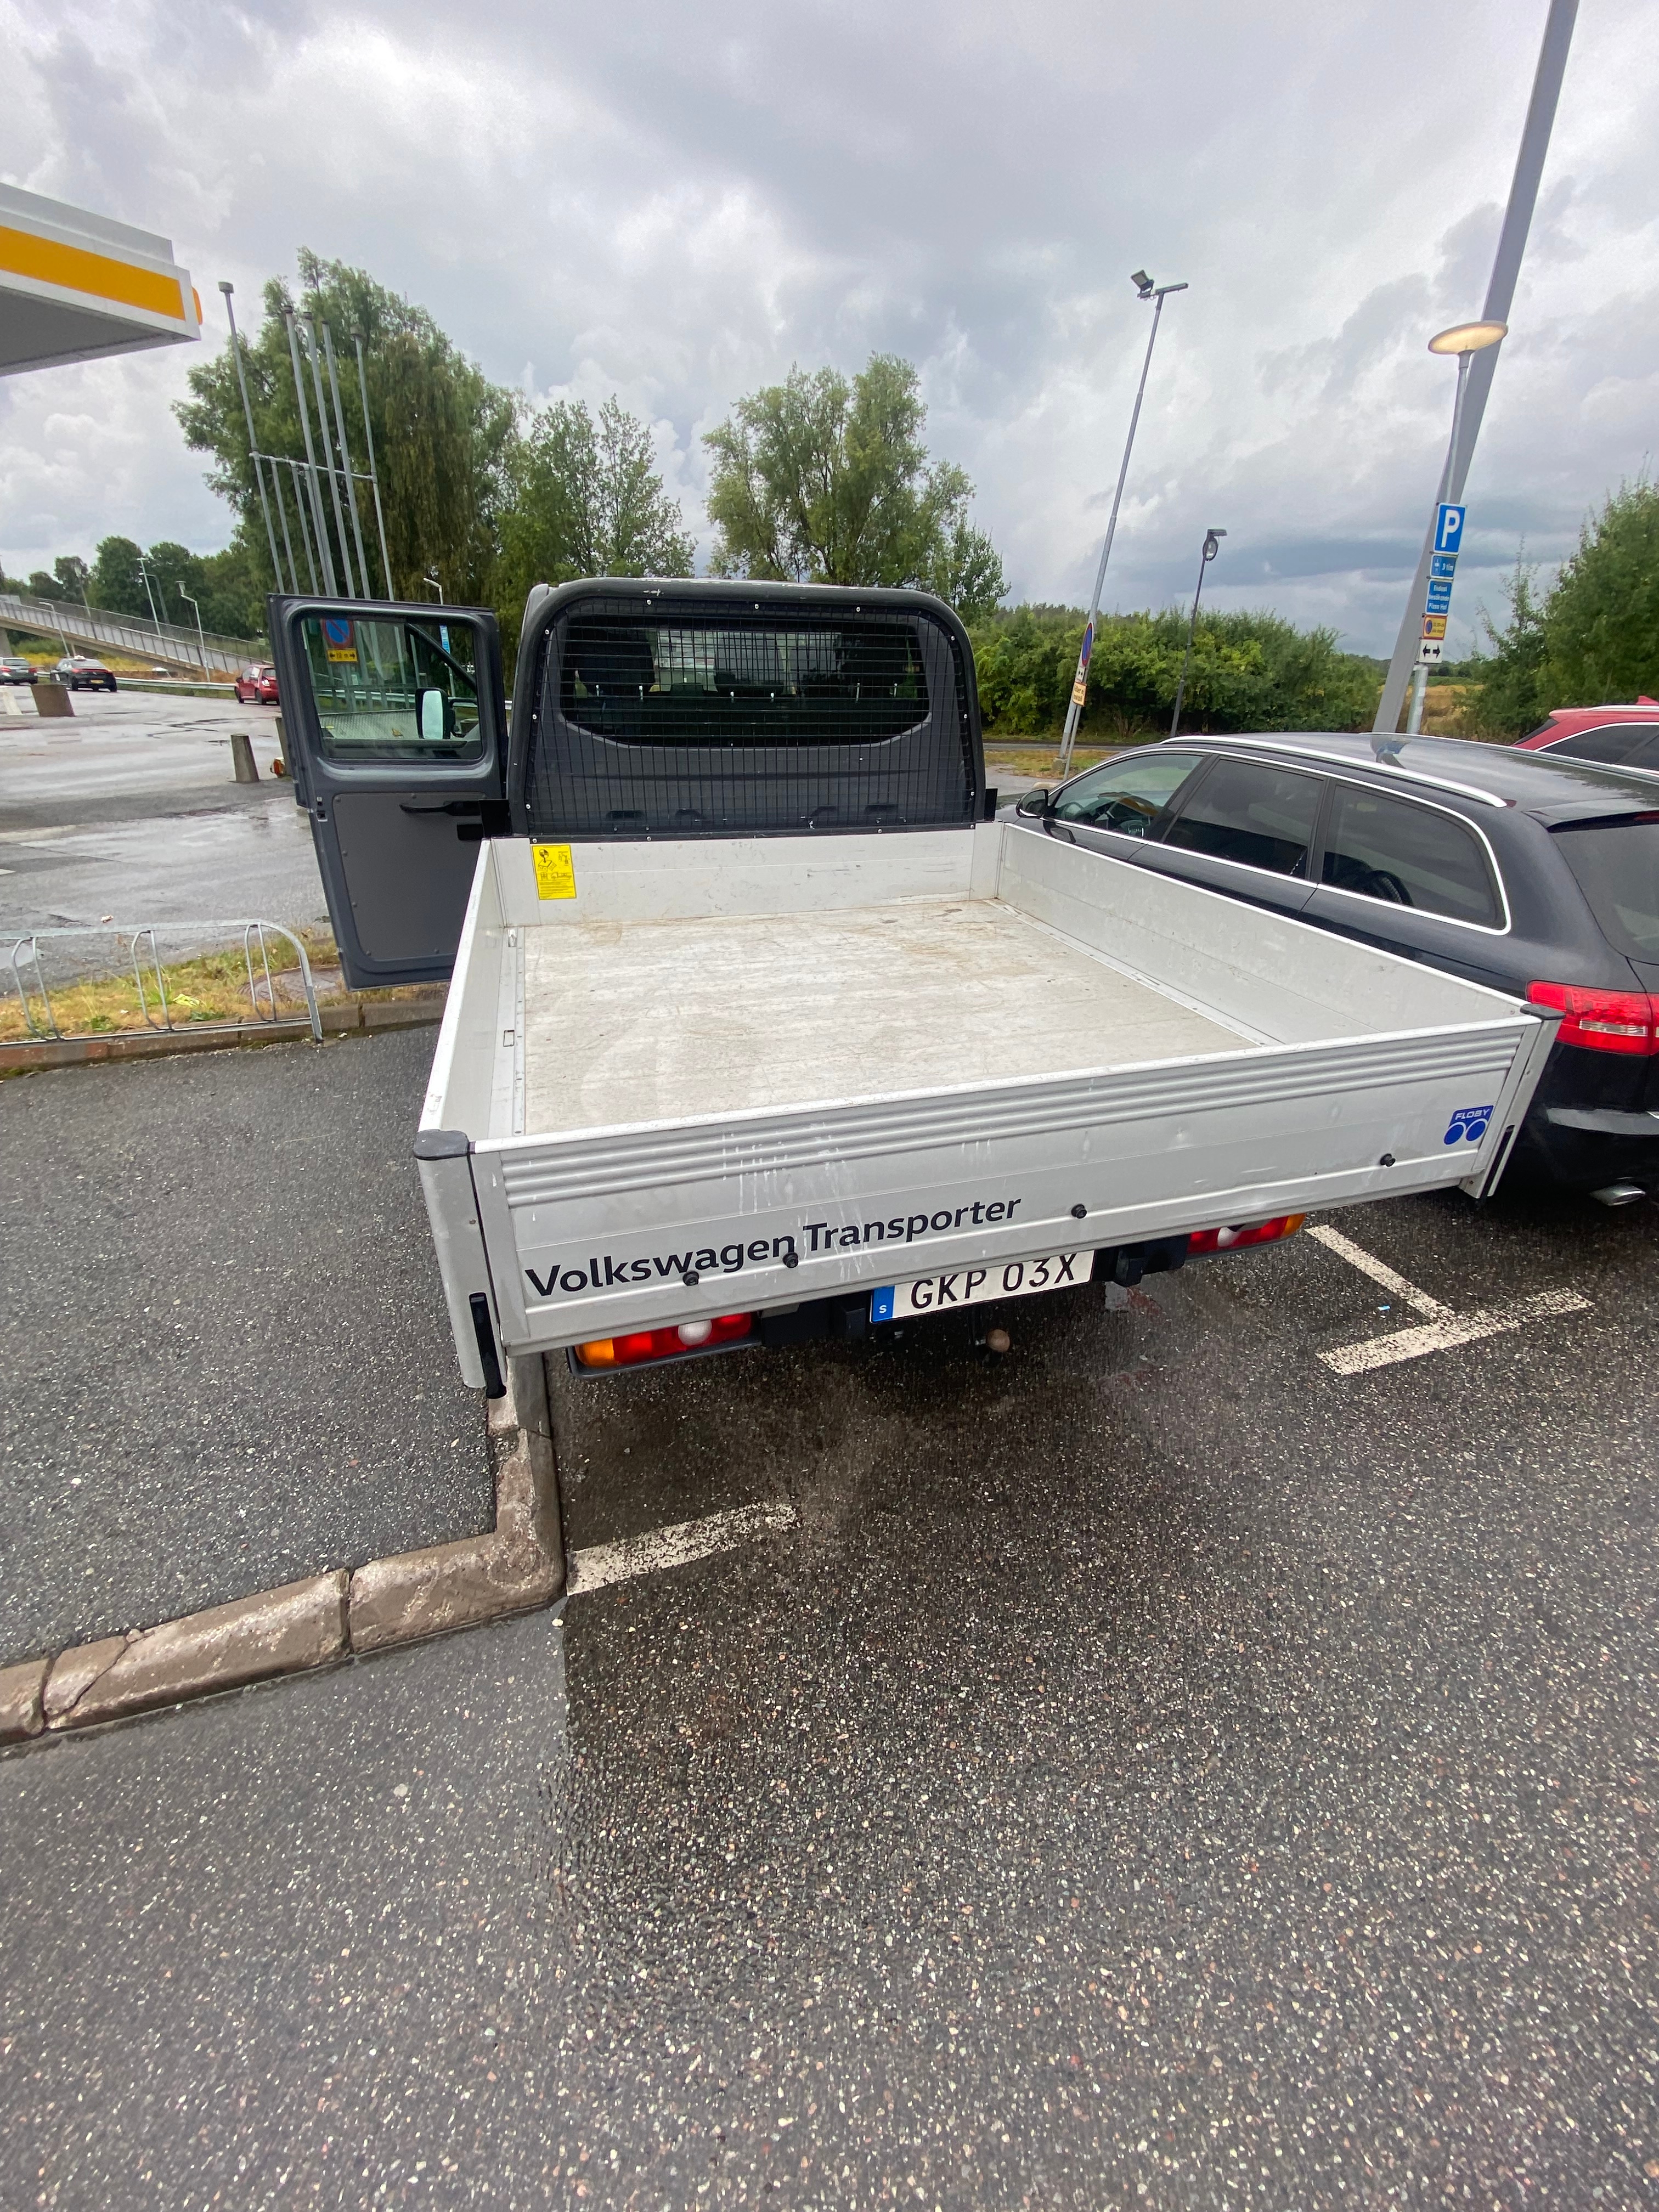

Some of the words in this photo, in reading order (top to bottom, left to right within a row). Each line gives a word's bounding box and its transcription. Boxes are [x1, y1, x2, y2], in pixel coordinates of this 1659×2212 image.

[1441, 509, 1460, 548] P
[1455, 1108, 1490, 1120] FLOBY
[524, 1234, 795, 1297] Volkswagen
[803, 1198, 1022, 1252] Transporter
[911, 1269, 987, 1309] GKP
[1002, 1253, 1077, 1291] 03X
[879, 1305, 887, 1314] S
